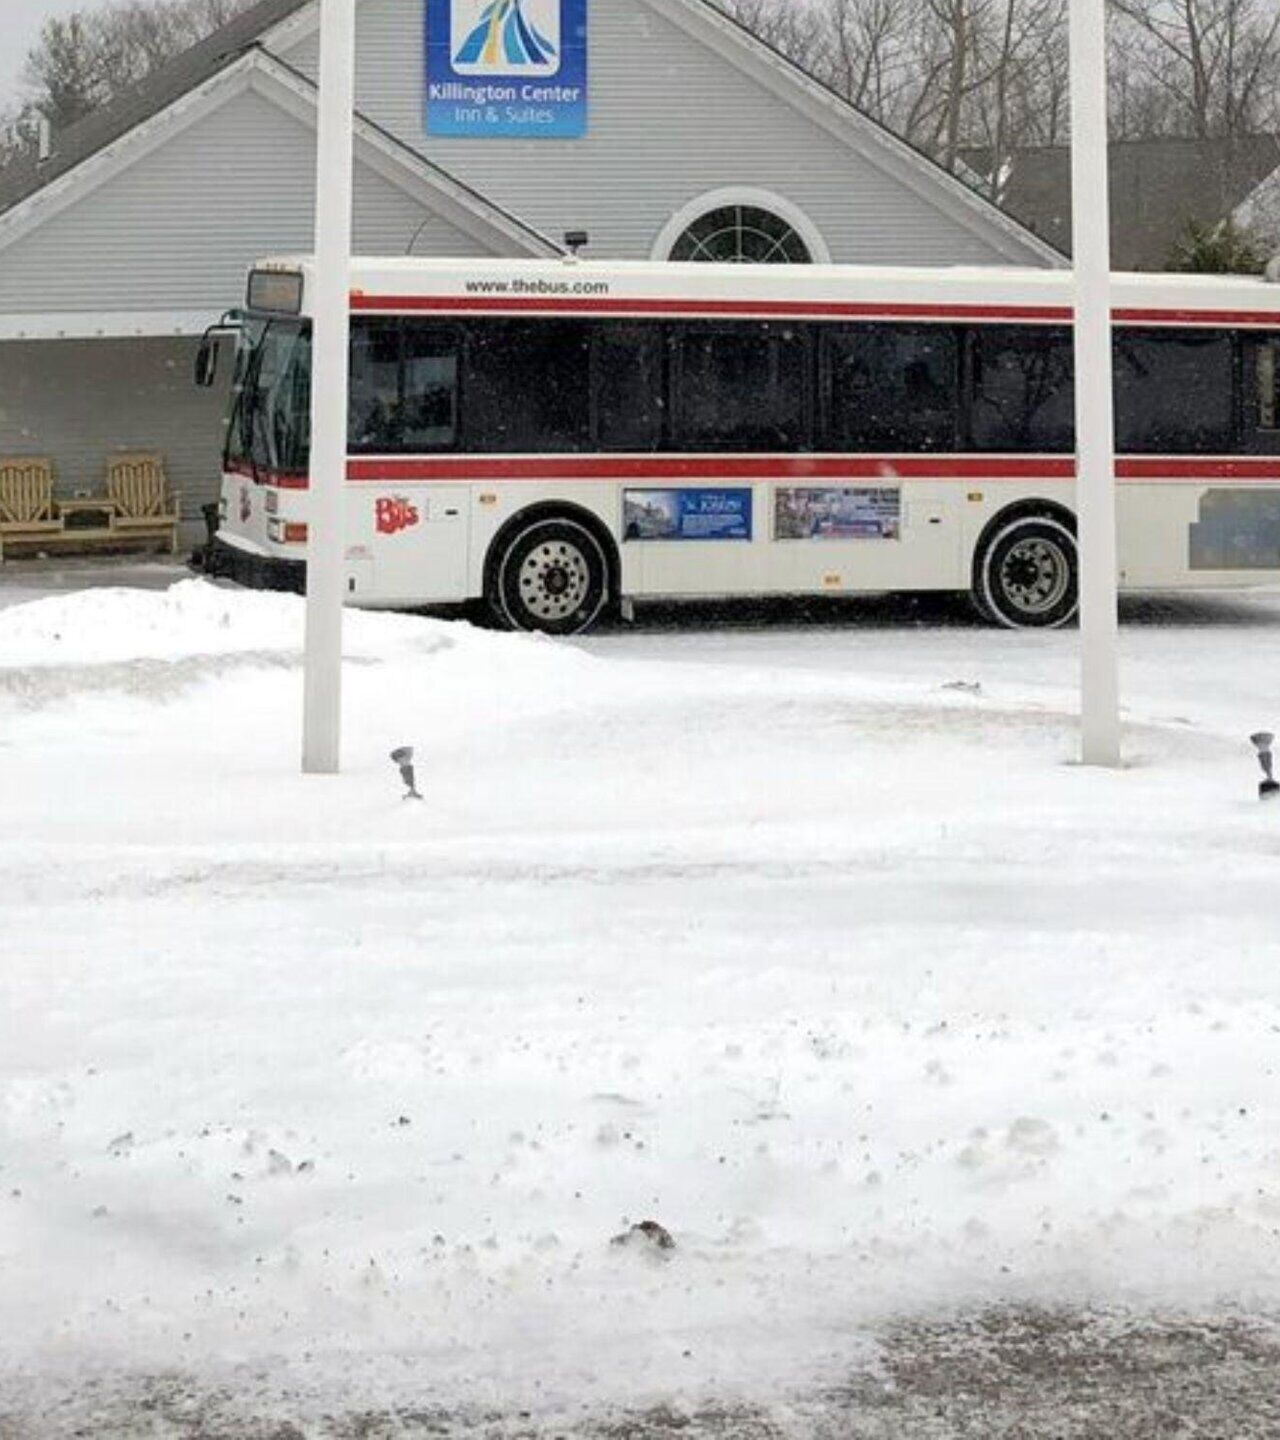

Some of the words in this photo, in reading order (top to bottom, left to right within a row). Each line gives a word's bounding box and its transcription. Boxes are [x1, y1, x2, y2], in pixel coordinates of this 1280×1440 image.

[429, 83, 516, 103] Killington
[522, 85, 580, 102] Center
[455, 108, 481, 122] Inn
[485, 107, 500, 122] &
[506, 107, 554, 123] Suites
[465, 279, 609, 294] www.thebus.com
